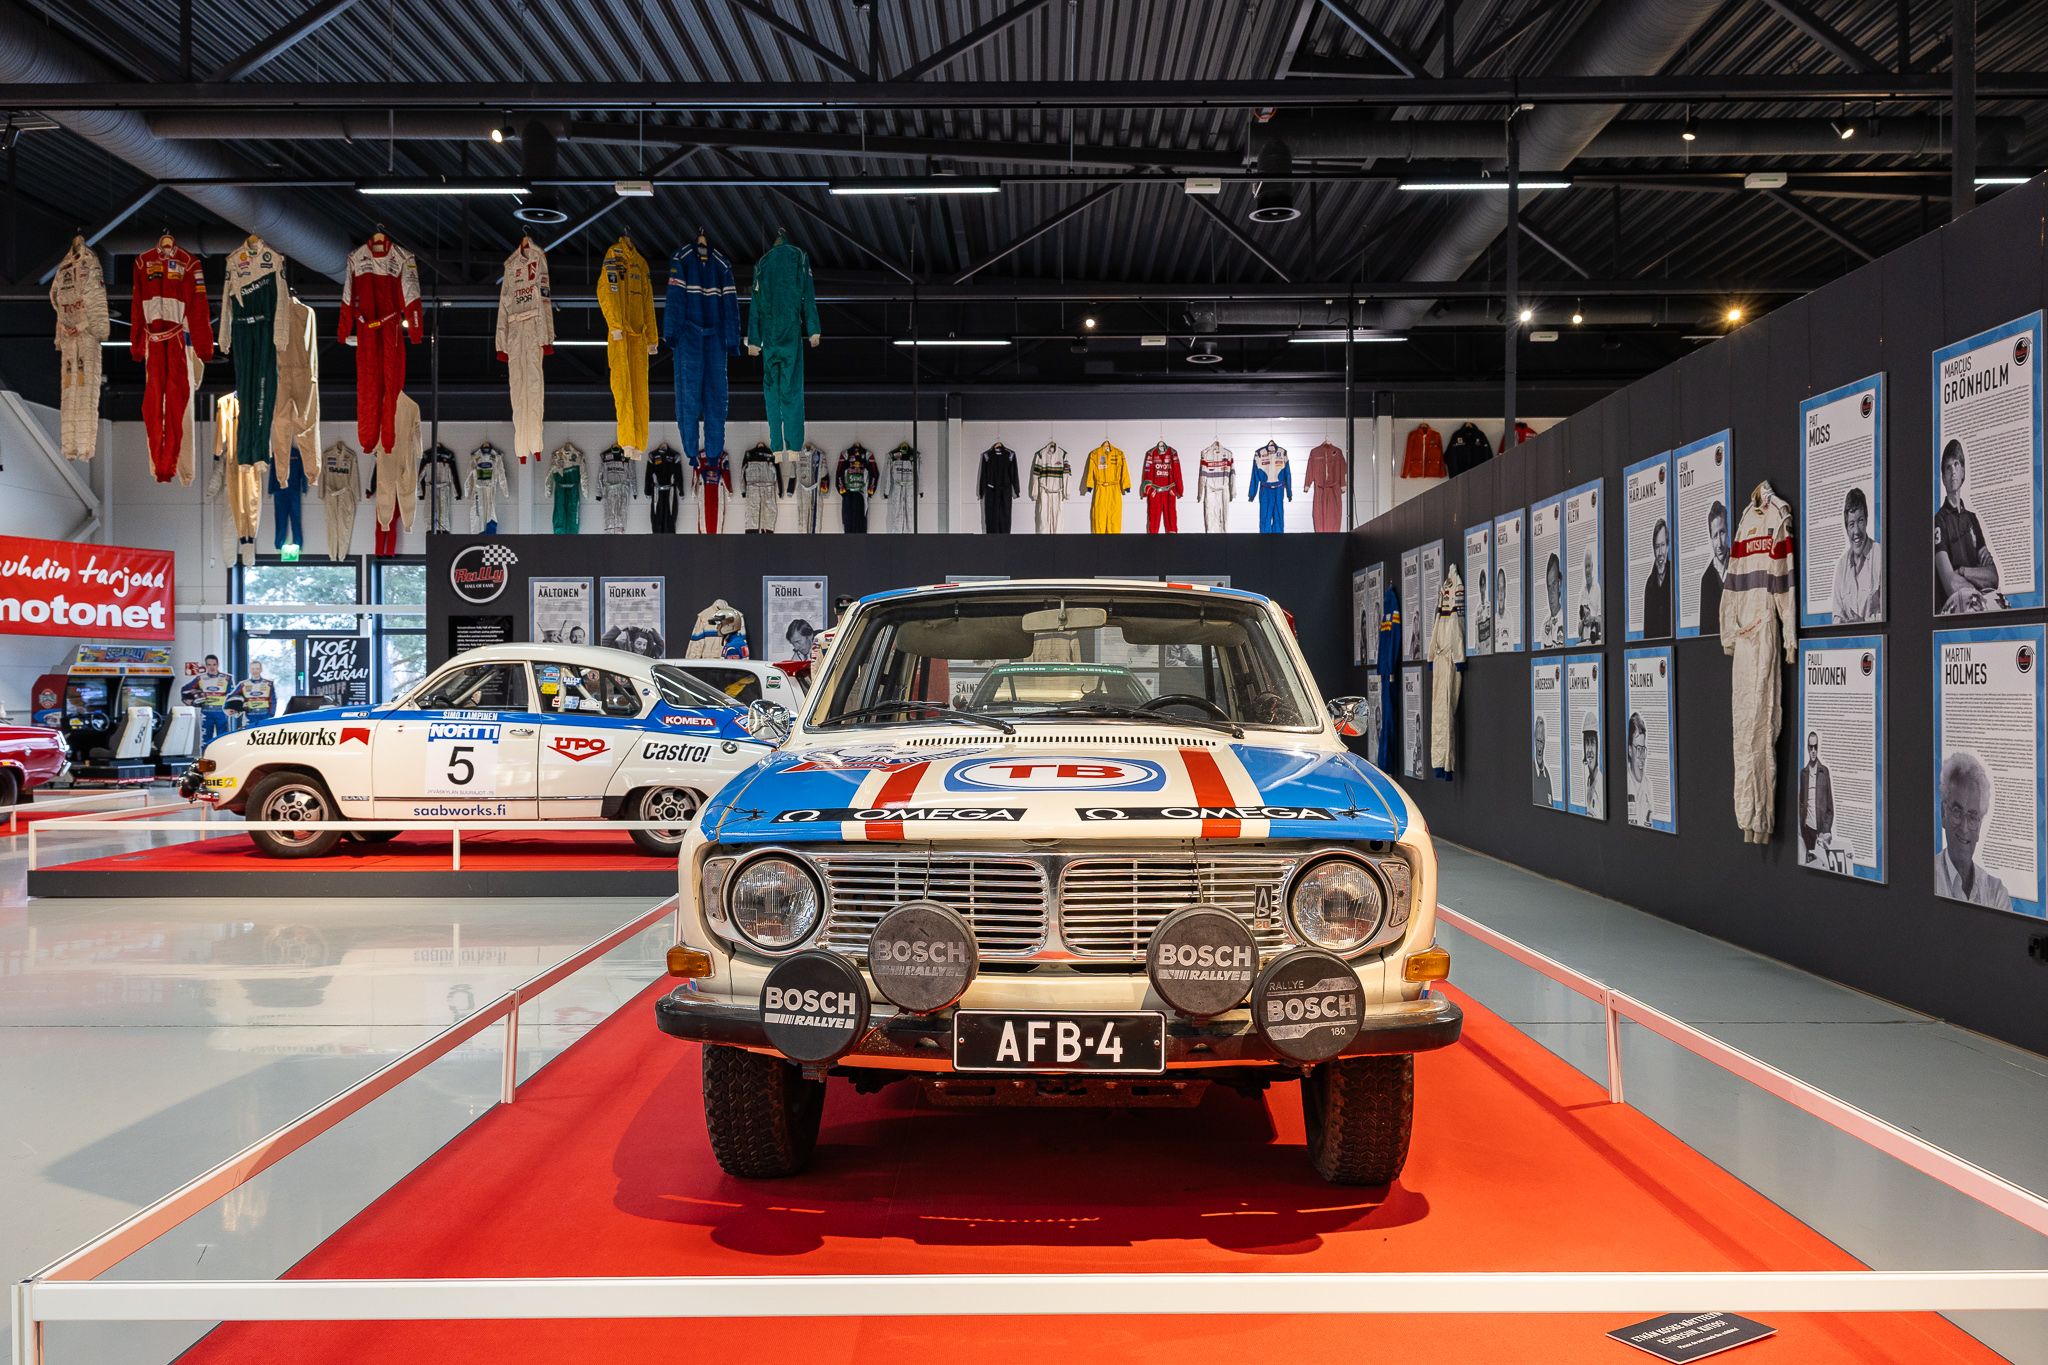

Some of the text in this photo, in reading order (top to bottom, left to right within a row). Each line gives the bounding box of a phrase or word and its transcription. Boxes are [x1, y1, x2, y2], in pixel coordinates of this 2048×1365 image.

[1945, 356, 1971, 379] MARCUS
[1944, 363, 2009, 404] GRÖNHOLM
[1809, 414, 1818, 428] PAT
[1809, 424, 1830, 447] MOSS
[1680, 470, 1695, 488] TODT
[1629, 481, 1656, 504] HARJANNE
[0, 555, 165, 597] uhdin tarjoaa
[455, 566, 505, 583] Rally
[538, 588, 579, 597] AALTONEN
[609, 588, 646, 597] HOPKIRK
[775, 586, 803, 597] RÖHRL
[311, 639, 357, 658] KOE!
[1945, 648, 1971, 663] MARTIN
[313, 654, 357, 677] JAA!
[1808, 654, 1823, 666] PAULI
[318, 668, 368, 682] SEURAA!
[1630, 673, 1653, 688] SALONEN
[1808, 667, 1846, 686] TOIVONEN
[1945, 663, 1987, 685] HOLMES
[1569, 676, 1590, 690] LAMPINEN
[442, 711, 498, 721] SIMO LAMPINEN
[665, 716, 714, 726] KOMETA
[246, 727, 336, 746] Saabworks
[429, 724, 501, 738] NORTTI
[555, 737, 605, 751] UPO
[642, 742, 712, 763] Castrol
[447, 746, 474, 785] 5
[989, 764, 1125, 779] TB
[413, 804, 506, 816] saabworks.fi
[853, 808, 1016, 821] OMEGA
[1161, 807, 1325, 820] OMEGA
[874, 940, 966, 963] BOSCH
[1158, 943, 1251, 967] BOSCH
[904, 966, 954, 977] RALLYE
[1189, 970, 1241, 980] RALLYE
[1269, 980, 1305, 991] RALLYE
[765, 986, 856, 1015] BOSCH
[1266, 994, 1357, 1022] BOSCH
[796, 1015, 845, 1028] RALLYE
[1331, 1026, 1346, 1036] 180
[1656, 1323, 1685, 1335] KOSKE
